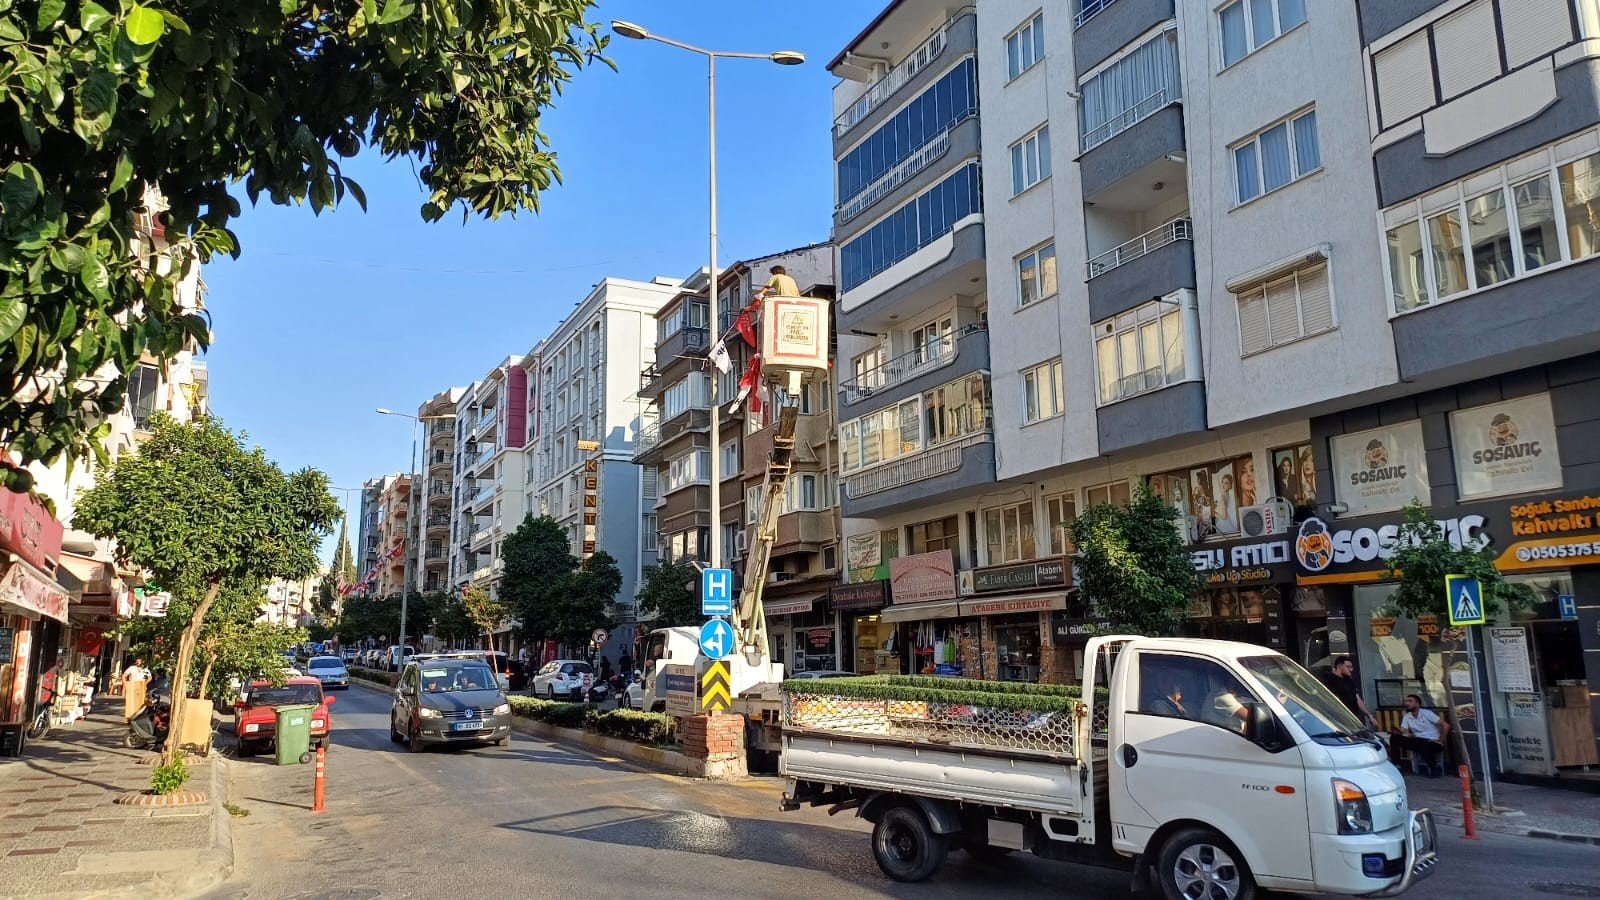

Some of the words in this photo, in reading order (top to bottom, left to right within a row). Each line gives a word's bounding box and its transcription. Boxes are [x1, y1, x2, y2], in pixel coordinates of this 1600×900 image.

[1265, 508, 1273, 535] VESTEL
[1512, 514, 1591, 536] Kahvaltı
[1241, 567, 1270, 580] Studio
[708, 573, 726, 598] H
[1562, 598, 1576, 615] H
